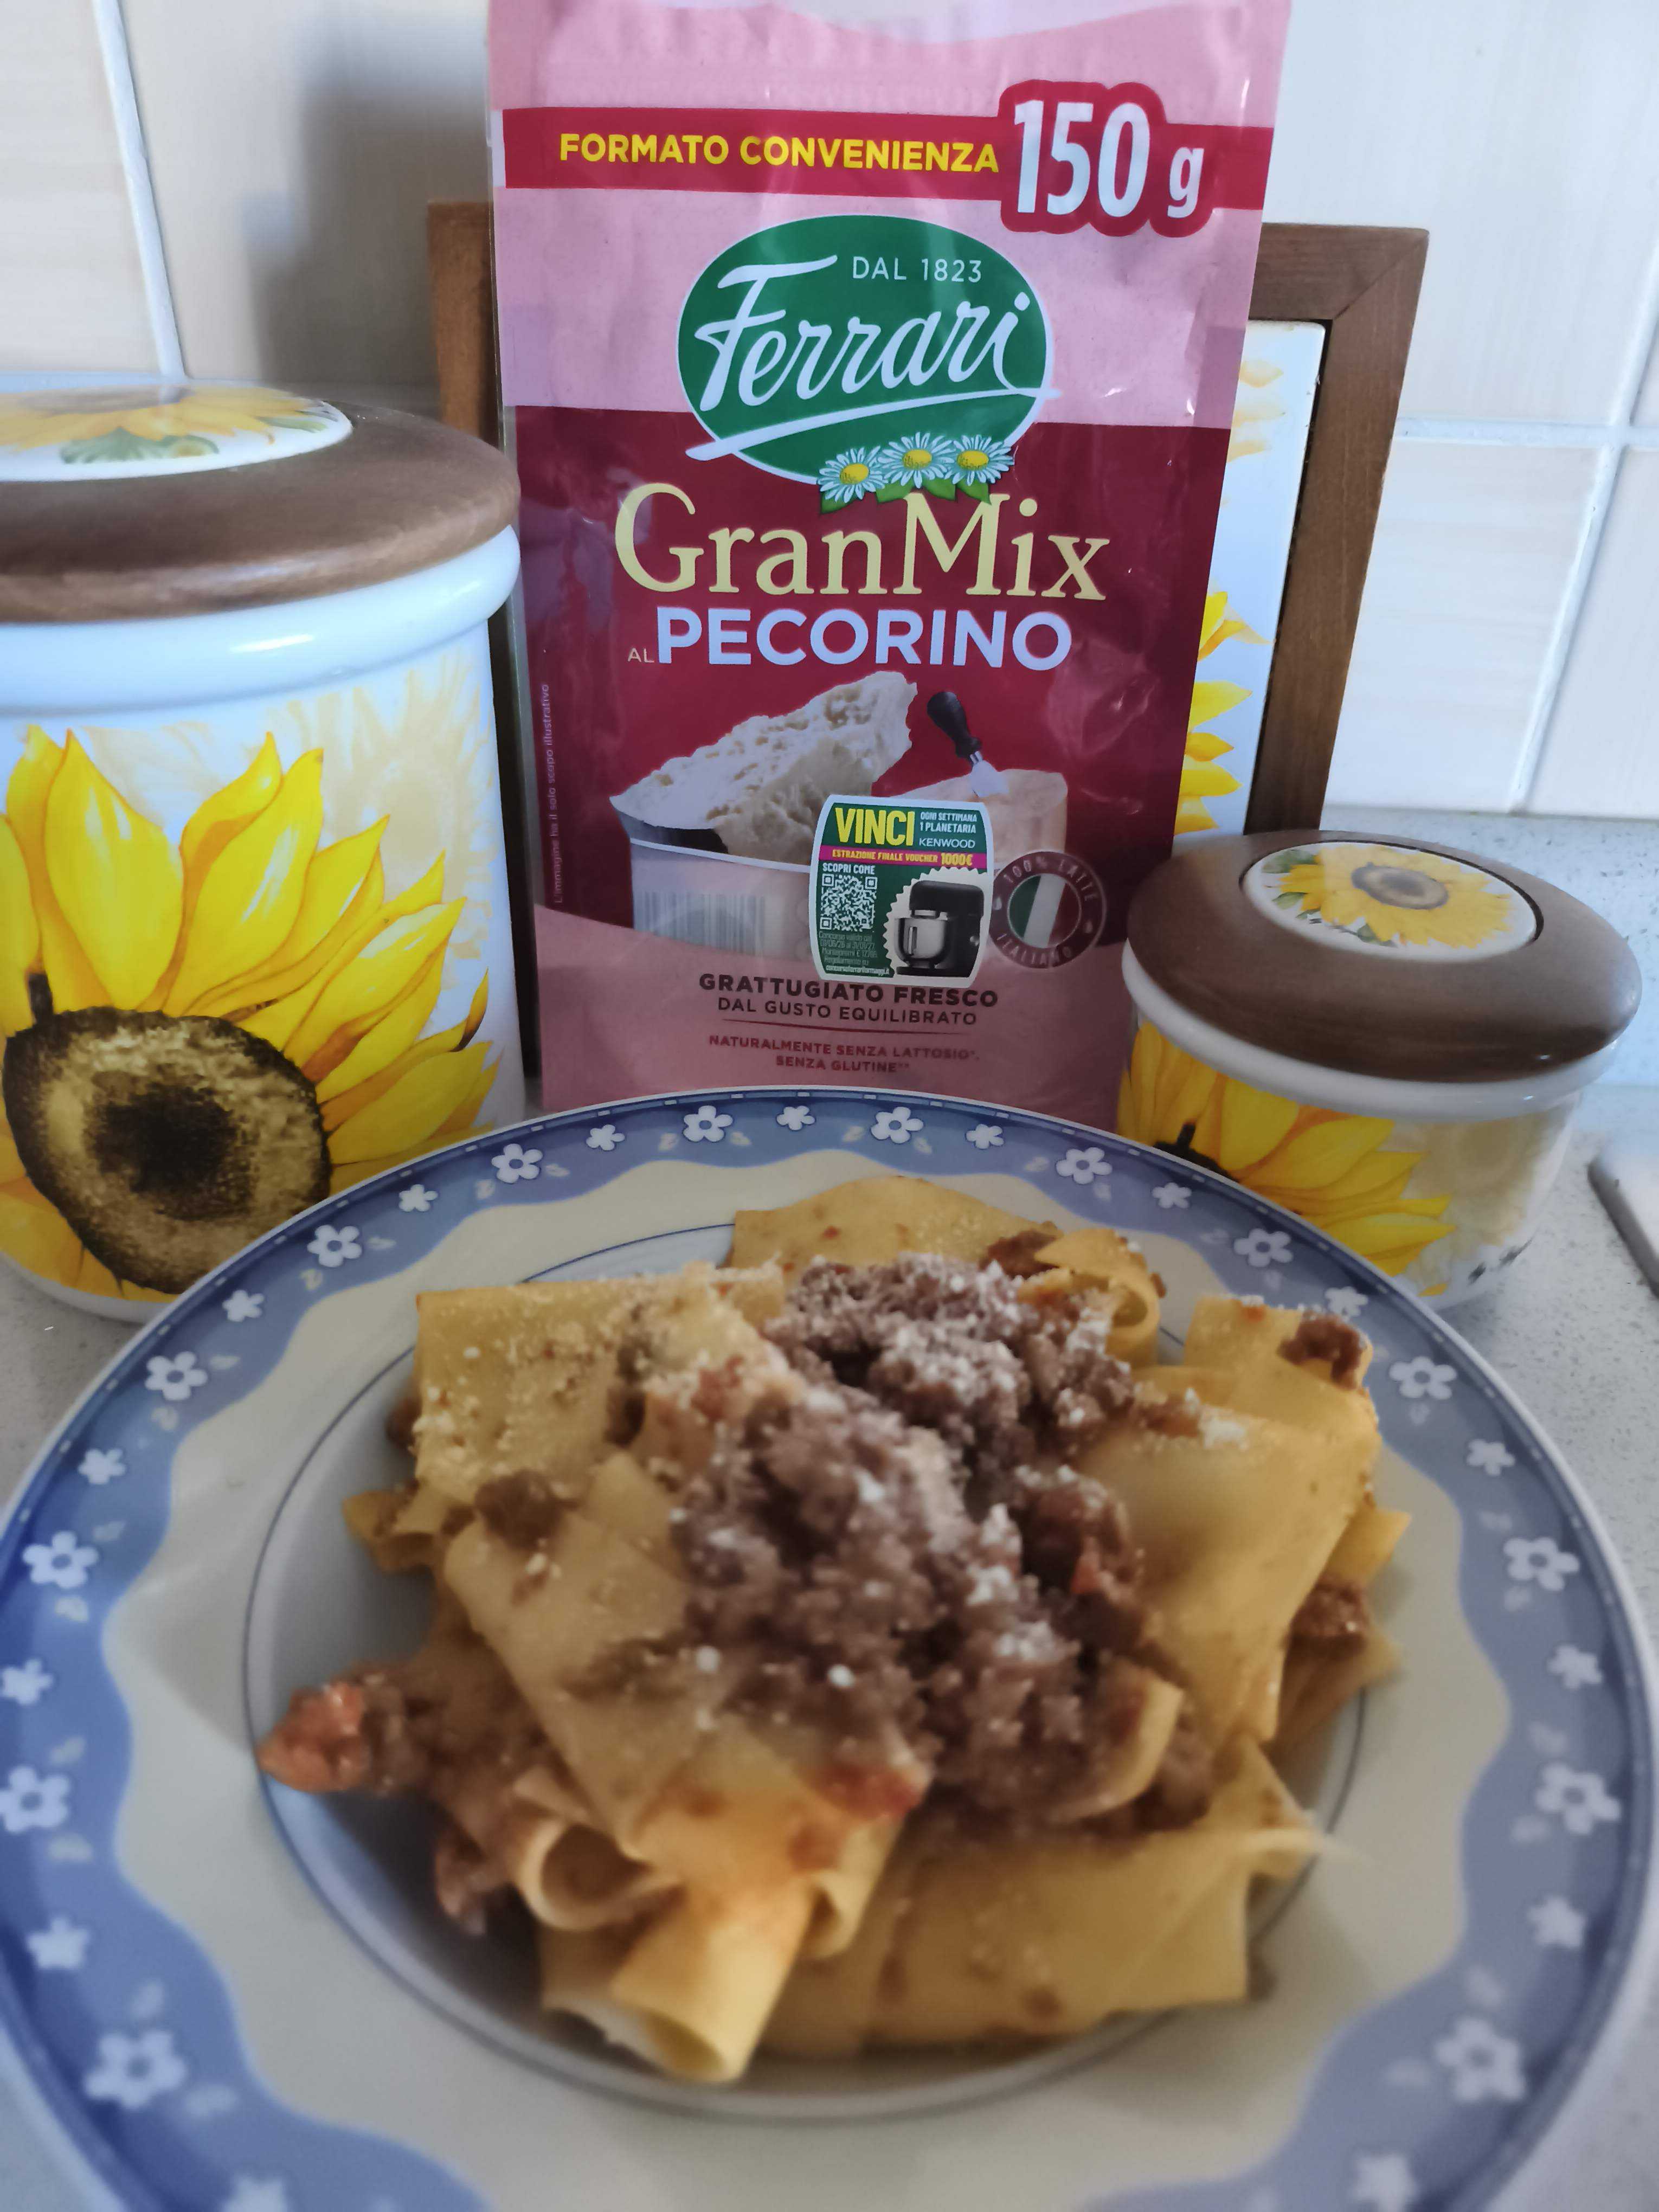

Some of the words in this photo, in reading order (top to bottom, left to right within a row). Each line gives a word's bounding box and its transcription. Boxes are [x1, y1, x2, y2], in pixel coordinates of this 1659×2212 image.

[560, 133, 729, 164] FORMATO
[740, 135, 999, 174] CONVENIENZA
[1014, 100, 1150, 218] 150
[1168, 145, 1204, 218] g
[852, 256, 906, 281] DAL
[921, 258, 982, 284] 1823
[692, 255, 1049, 415] Ferrari
[615, 483, 1110, 600] GranMix
[628, 648, 654, 663] AL
[657, 606, 1072, 671] PECORINO
[542, 684, 552, 745] illustrativo
[546, 749, 556, 783] scopo
[548, 788, 557, 810] solo
[835, 808, 915, 846] VINCI
[920, 822, 923, 831] 1
[925, 822, 976, 834] PLANETARIA
[921, 812, 937, 821] OGNI
[937, 813, 978, 822] SETTIMANA
[919, 838, 976, 848] KENWOOD
[822, 863, 851, 873] SCOPRI
[853, 864, 876, 875] COME
[832, 849, 876, 860] ESTRAZIONE
[877, 851, 903, 861] FINALE
[905, 852, 938, 863] VOUCHER
[941, 852, 974, 866] 1000€
[699, 973, 884, 1002] GRATTUGIATO
[894, 988, 998, 1007] FRESCO
[718, 997, 756, 1013] DAL
[764, 1000, 831, 1019] GUSTO
[840, 1006, 976, 1025] EQUILIBRATO
[709, 1035, 831, 1054] NATURALMENTE
[837, 1045, 887, 1057] SENZA
[776, 1056, 826, 1070] SENZA
